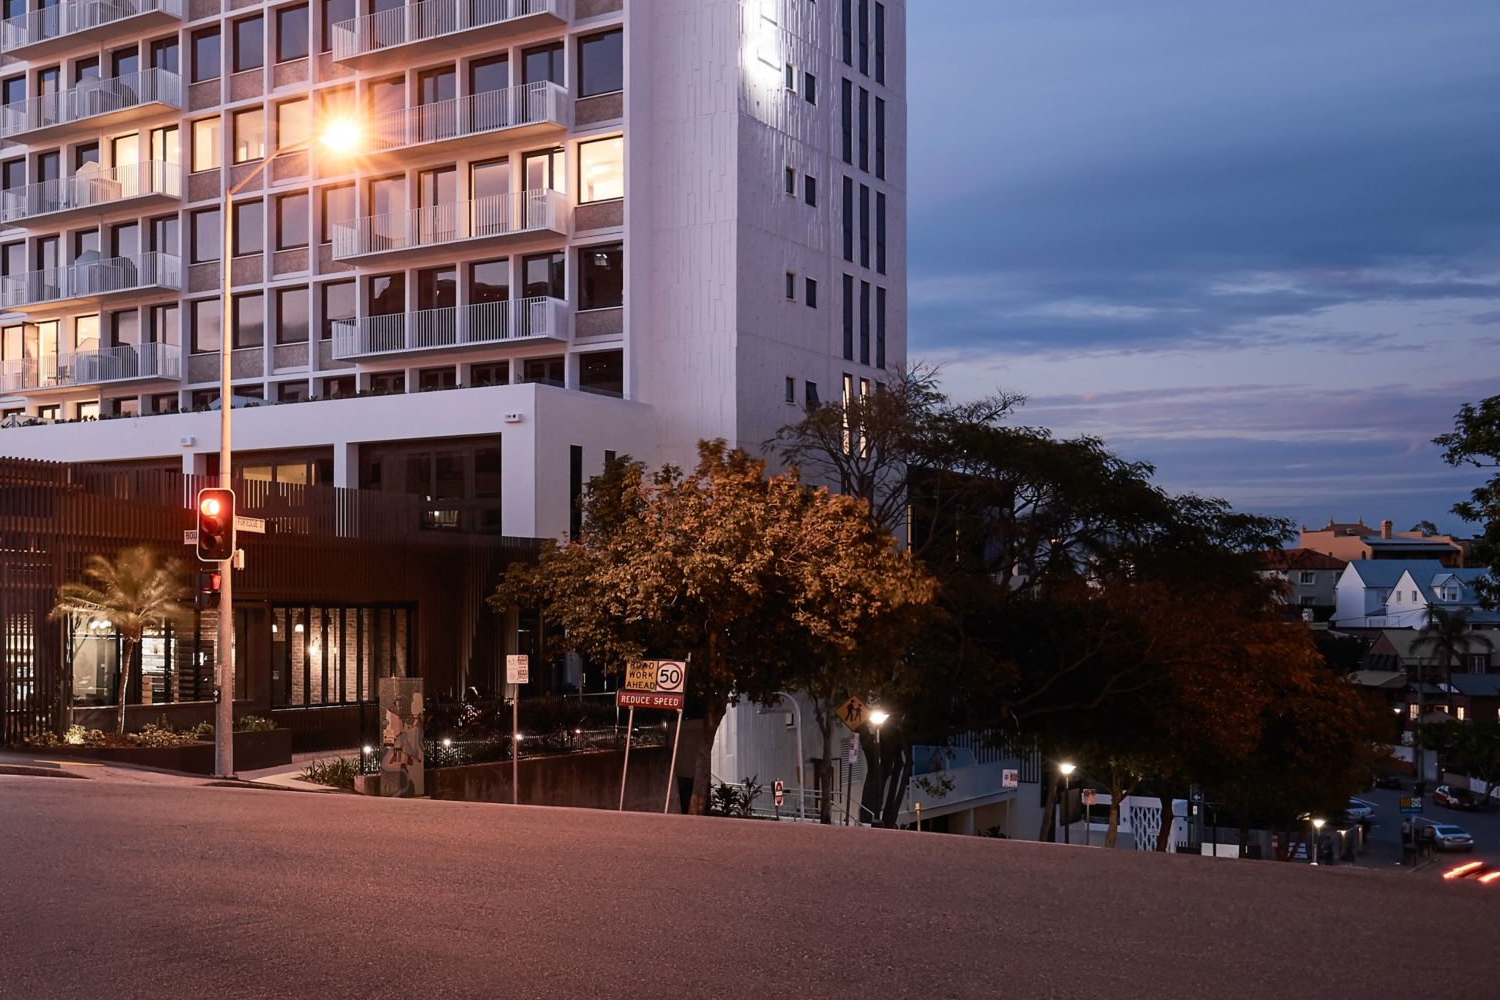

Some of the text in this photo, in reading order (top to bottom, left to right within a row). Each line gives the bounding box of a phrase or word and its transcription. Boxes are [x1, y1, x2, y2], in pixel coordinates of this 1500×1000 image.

[185, 531, 197, 540] BOU
[629, 661, 655, 670] ROAD
[629, 671, 654, 680] WORK
[660, 669, 680, 684] 50
[626, 681, 656, 690] AHEAD
[621, 695, 679, 707] REDUCE SPEED
